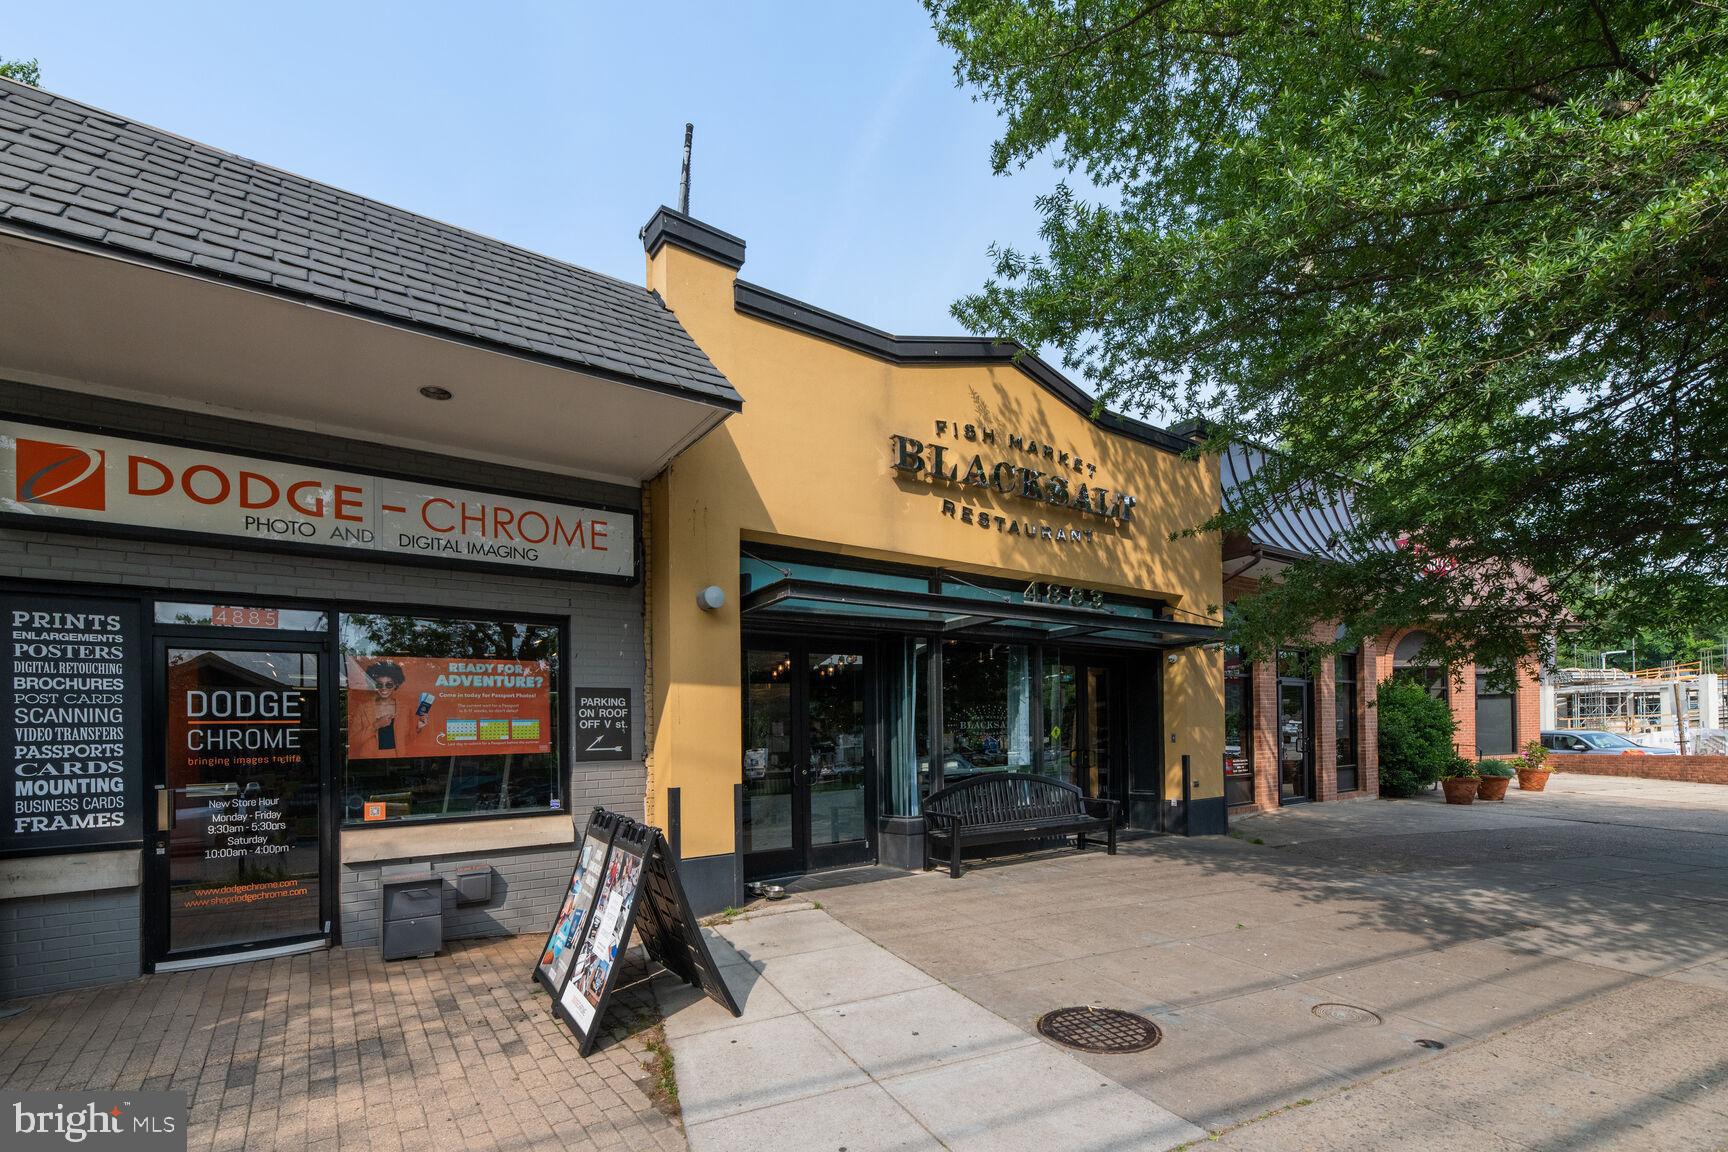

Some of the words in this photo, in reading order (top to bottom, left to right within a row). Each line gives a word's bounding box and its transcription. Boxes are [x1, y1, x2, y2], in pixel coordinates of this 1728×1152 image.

[935, 420, 995, 444] FISH
[1008, 433, 1097, 478] MARKET
[890, 433, 1137, 521] BLACKSALT
[127, 455, 364, 522] DODGE
[421, 498, 609, 552] CHROME
[941, 499, 1095, 543] RESTAURANT
[245, 516, 316, 537] PHOTO
[330, 526, 375, 543] AND
[399, 533, 463, 554] DIGITAL
[466, 540, 539, 561] IMAGING
[12, 611, 121, 631] PRINTS
[216, 611, 277, 626] 4885
[12, 631, 123, 643] ENLARGEMENTS
[13, 643, 123, 660] POSTERS
[13, 661, 56, 674] DIGITAL
[59, 662, 123, 675] RETOUCHING
[448, 662, 495, 673] READY
[497, 664, 524, 674] FOR
[13, 677, 124, 690] BROCHURES
[435, 675, 544, 689] ADVENTURE?
[14, 693, 59, 704] POST
[63, 693, 123, 704] CARDS
[186, 690, 301, 718] DODGE
[580, 697, 626, 707] PARKING
[15, 708, 123, 724] SCANNING
[579, 709, 595, 718] ON
[598, 709, 628, 718] ROOF
[580, 720, 601, 729] OFF
[604, 720, 612, 729] V
[15, 728, 53, 742] VIDEO
[55, 727, 124, 741] TRANSFERS
[187, 728, 301, 751] CHROME
[14, 744, 124, 759] PASSPORTS
[187, 756, 230, 766] bringing
[233, 756, 269, 765] images
[15, 761, 124, 777] CARDS
[15, 778, 124, 797] MOUNTING
[15, 798, 79, 814] BUSINESS
[83, 796, 124, 810] CARDS
[208, 800, 231, 809] New
[232, 799, 257, 808] Store
[258, 797, 280, 806] Hour
[14, 812, 125, 833] FRAMES
[212, 813, 248, 823] Monday
[255, 811, 281, 821] Friday
[207, 825, 244, 835] 9:30am
[227, 835, 268, 846] Saturday
[204, 848, 248, 859] 10:00am
[254, 844, 290, 855] 4:00pm
[194, 879, 299, 897] www.dodgechrome.com
[184, 888, 308, 908] www.shopdodgechrome.com
